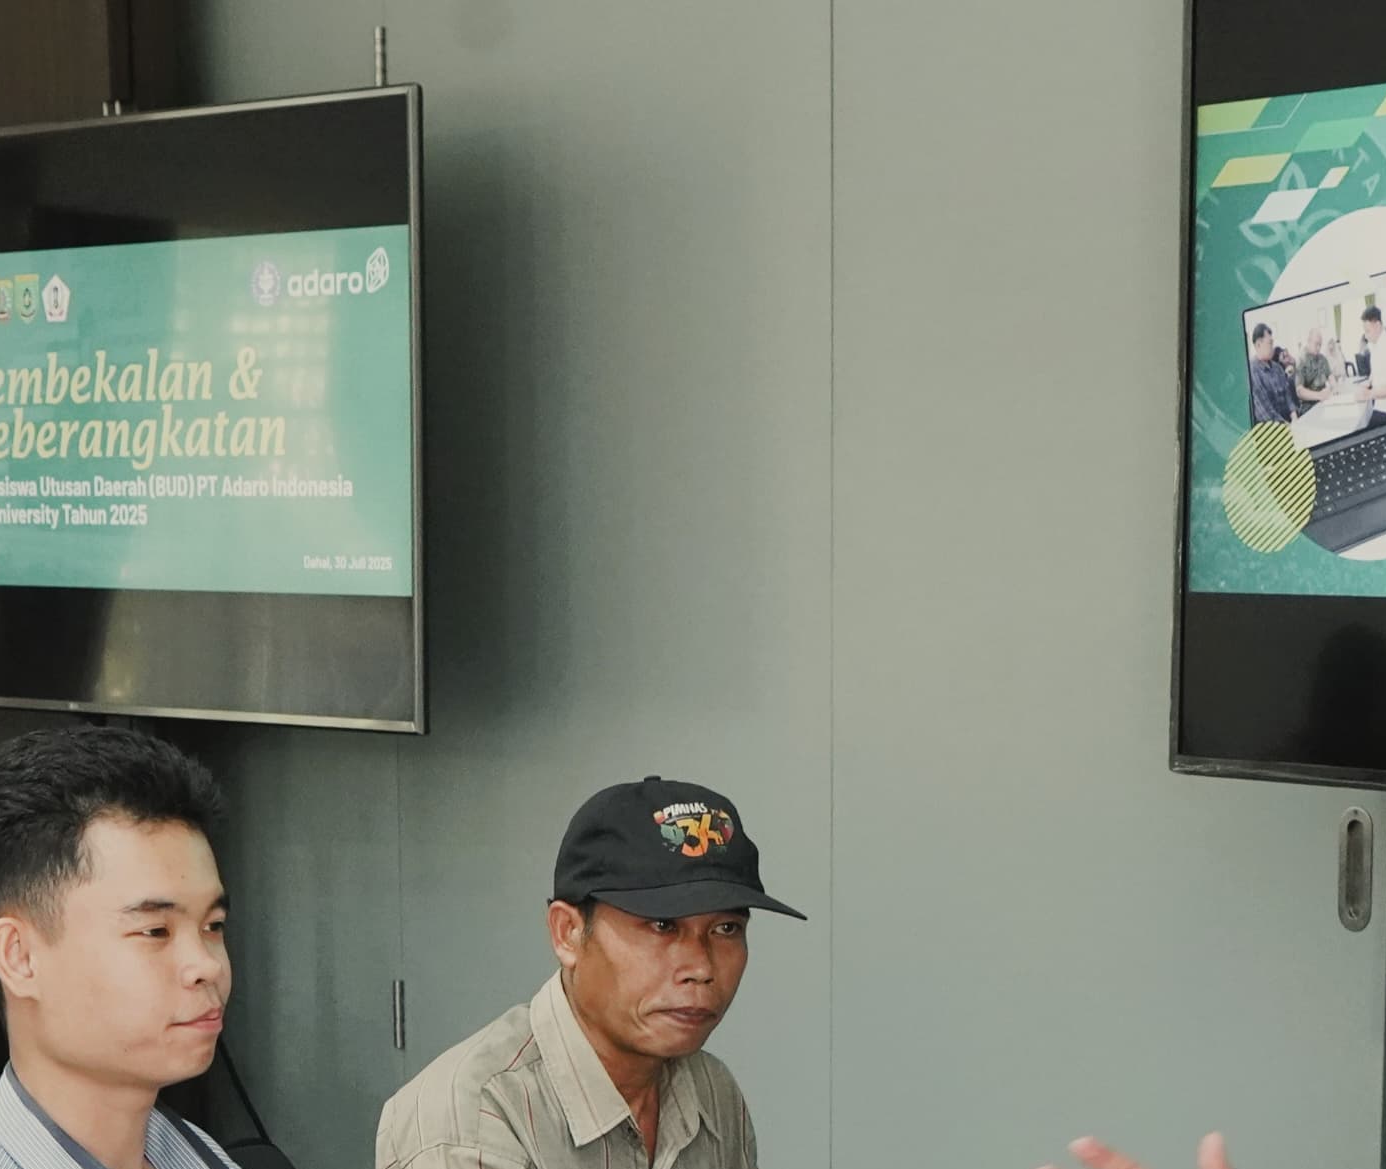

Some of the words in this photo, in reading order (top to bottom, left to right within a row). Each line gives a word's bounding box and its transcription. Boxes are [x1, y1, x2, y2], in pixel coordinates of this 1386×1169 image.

[287, 268, 363, 297] adaro
[228, 346, 264, 400] &
[39, 475, 91, 497] Utusan
[94, 474, 147, 497] Daerah
[148, 473, 195, 499] (BUD)
[196, 475, 218, 497] PT
[221, 475, 270, 497] Adaro
[272, 473, 354, 497] Indonesia
[61, 504, 107, 525] Tahun
[109, 504, 148, 525] 2025
[334, 556, 346, 569] 30
[368, 556, 393, 571] 2025
